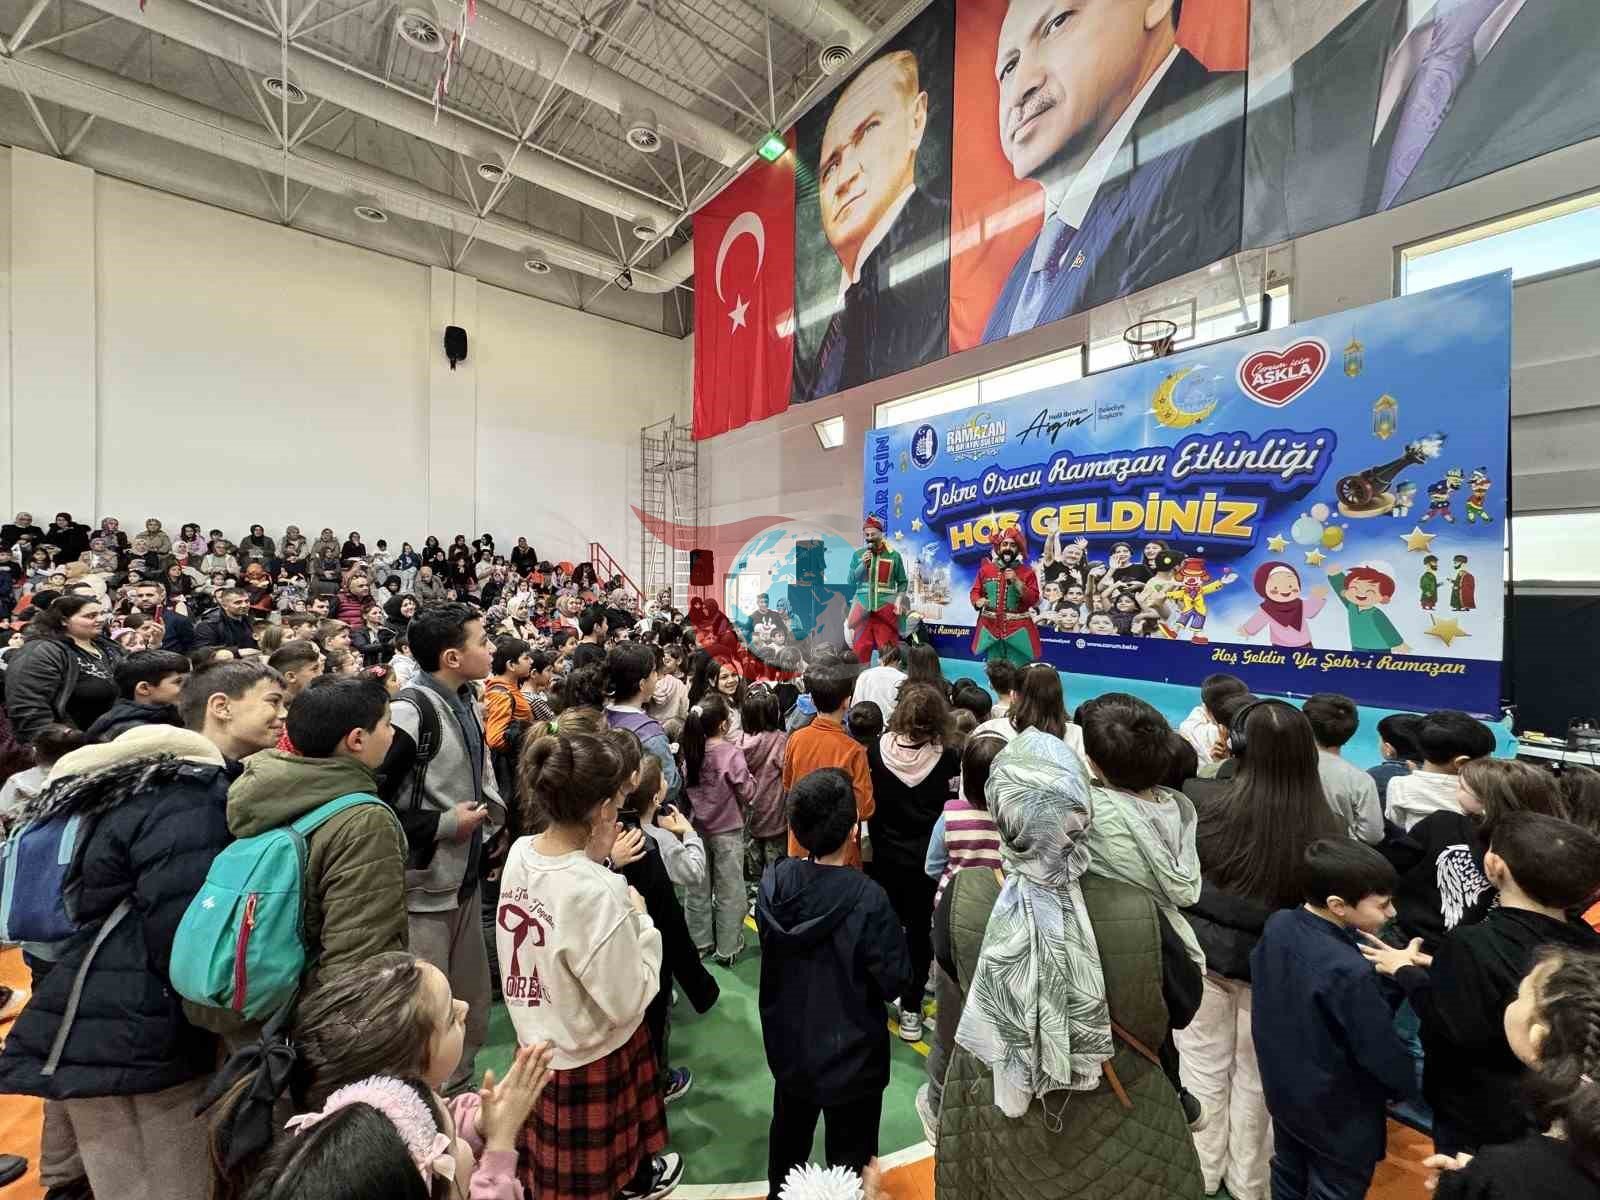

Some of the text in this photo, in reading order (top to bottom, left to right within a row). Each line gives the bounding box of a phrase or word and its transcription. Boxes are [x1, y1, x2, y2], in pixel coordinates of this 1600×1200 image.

[946, 420, 1006, 444] RAMAZAN
[872, 435, 894, 485] İÇİN
[927, 438, 1325, 515] Tekne Orucu Ramazan Etkinliği
[1031, 492, 1259, 536] GELDİNİZ
[1211, 648, 1466, 677] Hoş Geldin Ya Şehr-i Ramazan
